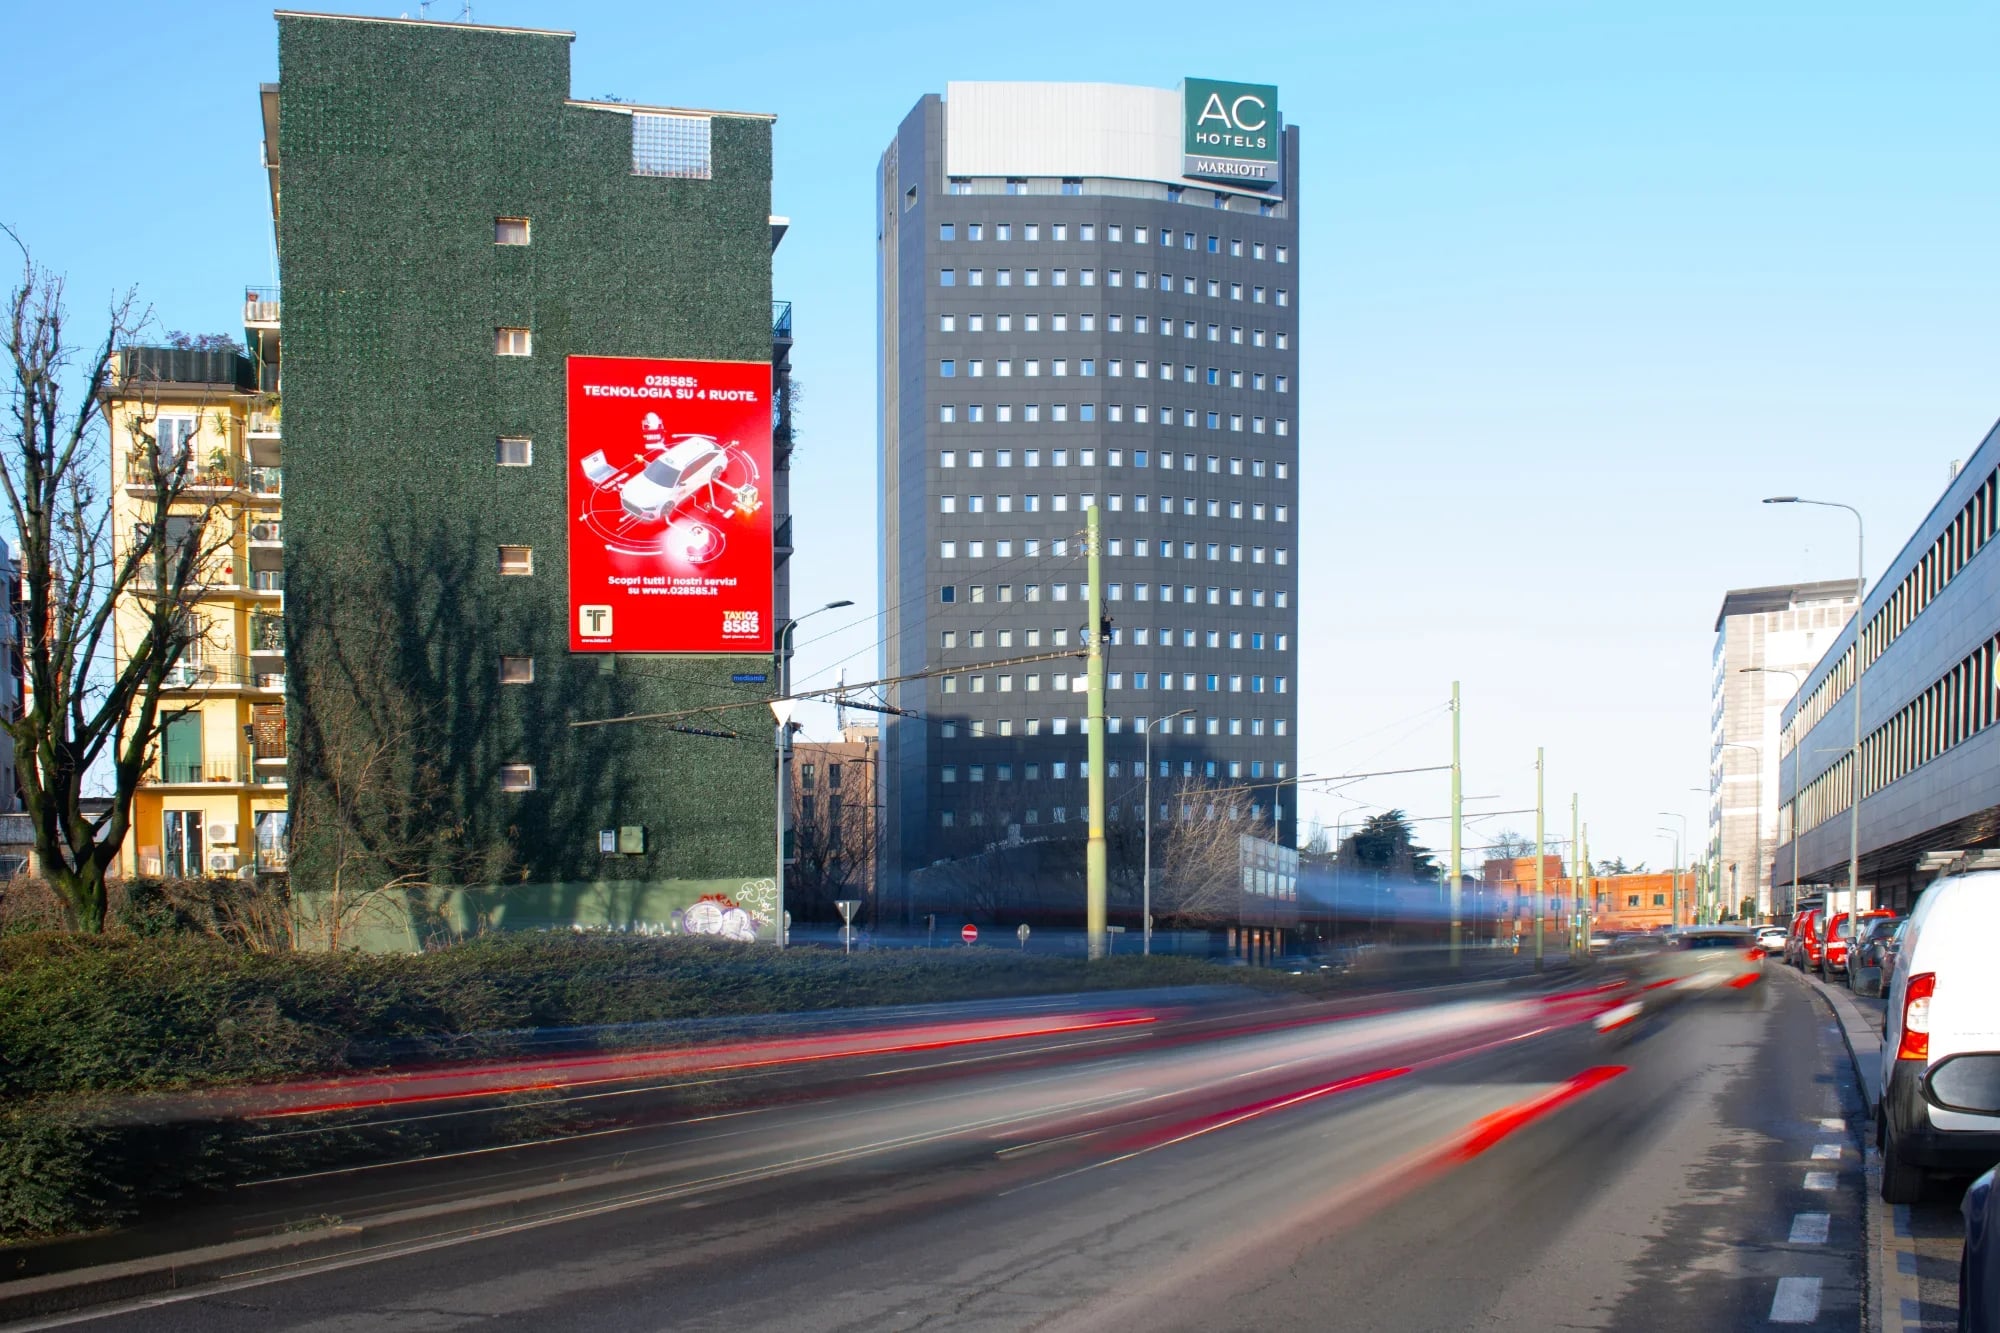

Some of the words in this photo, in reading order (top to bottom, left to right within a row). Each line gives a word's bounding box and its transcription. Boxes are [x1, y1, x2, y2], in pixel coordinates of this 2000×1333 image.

[1197, 93, 1266, 131] AC
[1196, 132, 1266, 148] HOTELS
[1197, 161, 1267, 177] MARRIOTT
[645, 375, 698, 387] 028585:
[583, 385, 673, 399] TECNOLOGIA
[676, 387, 694, 400] SU
[697, 388, 706, 400] 4
[709, 389, 758, 402] RUOTE.
[608, 576, 641, 586] Scopri
[643, 576, 665, 585] tutti
[667, 577, 671, 586] i
[673, 577, 702, 586] nostri
[704, 577, 737, 586] servizi
[642, 586, 718, 595] www.028585.it
[722, 620, 760, 633] 8585
